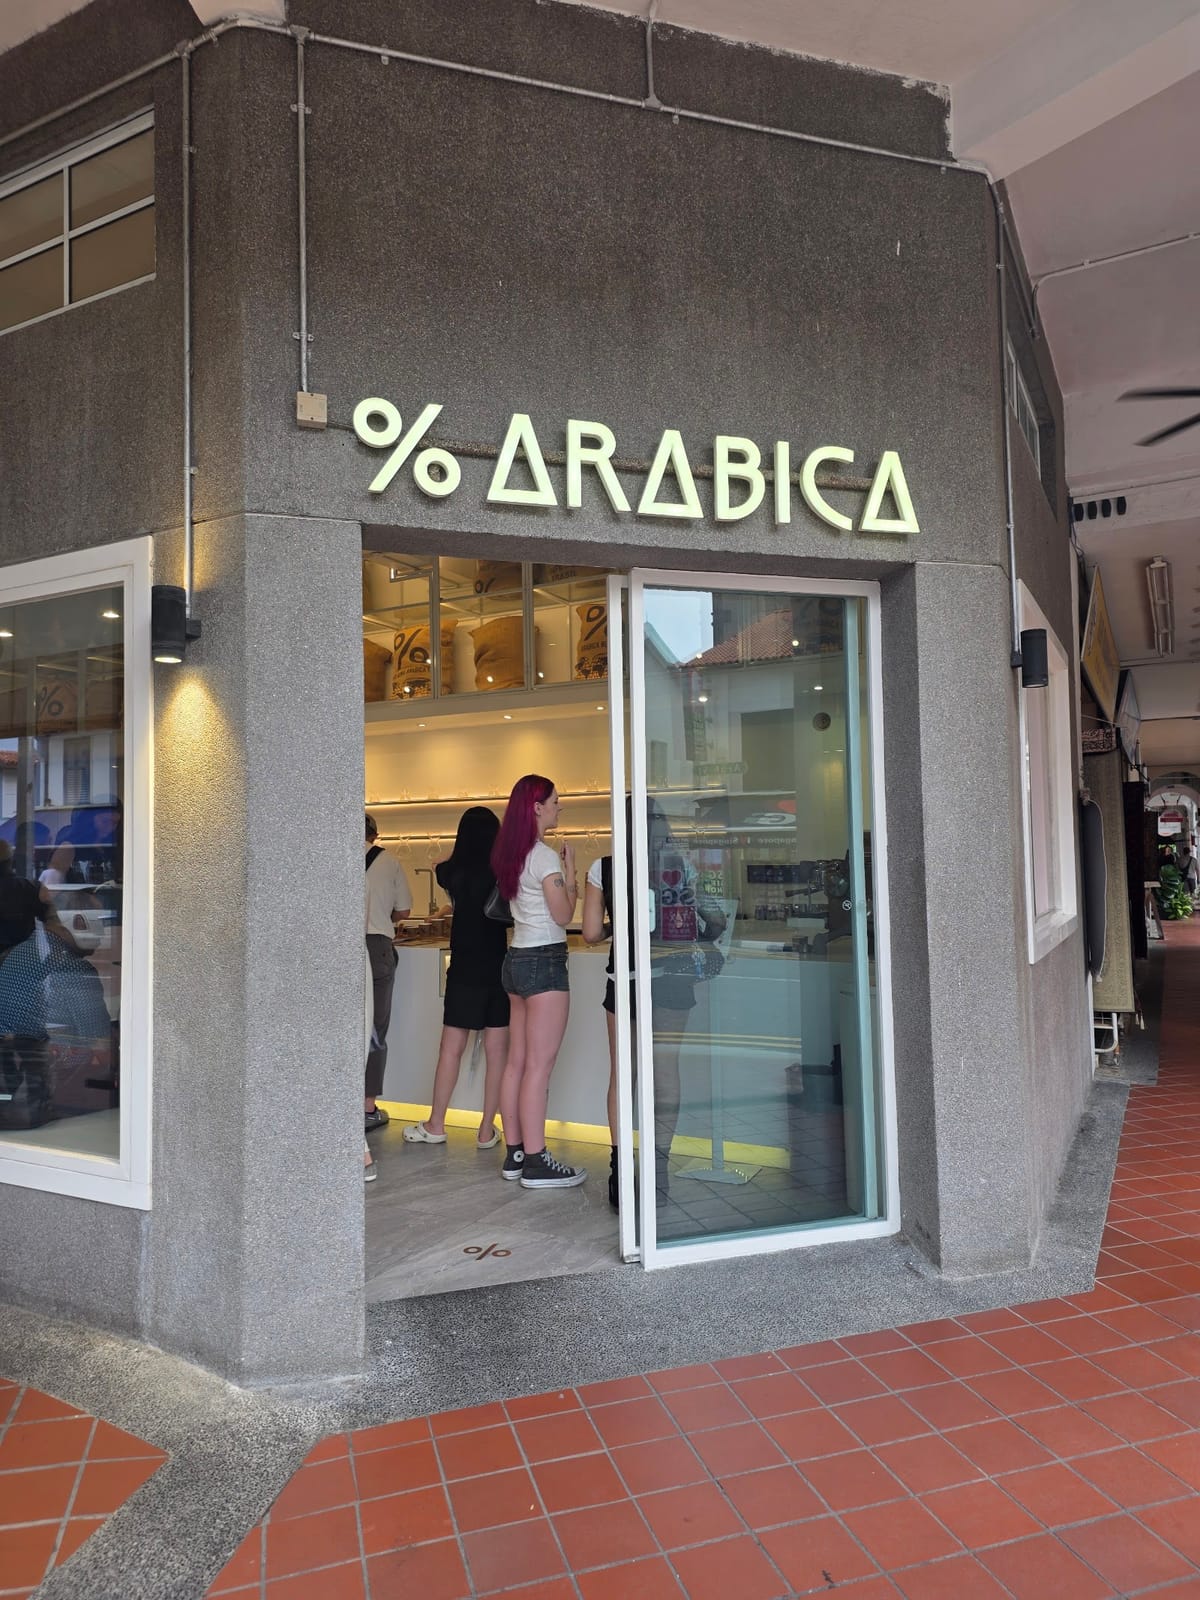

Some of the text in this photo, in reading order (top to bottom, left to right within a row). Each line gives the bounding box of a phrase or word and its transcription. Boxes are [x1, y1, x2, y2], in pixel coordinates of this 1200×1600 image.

[352, 397, 920, 534] % ARABICA
[462, 1242, 512, 1261] %
